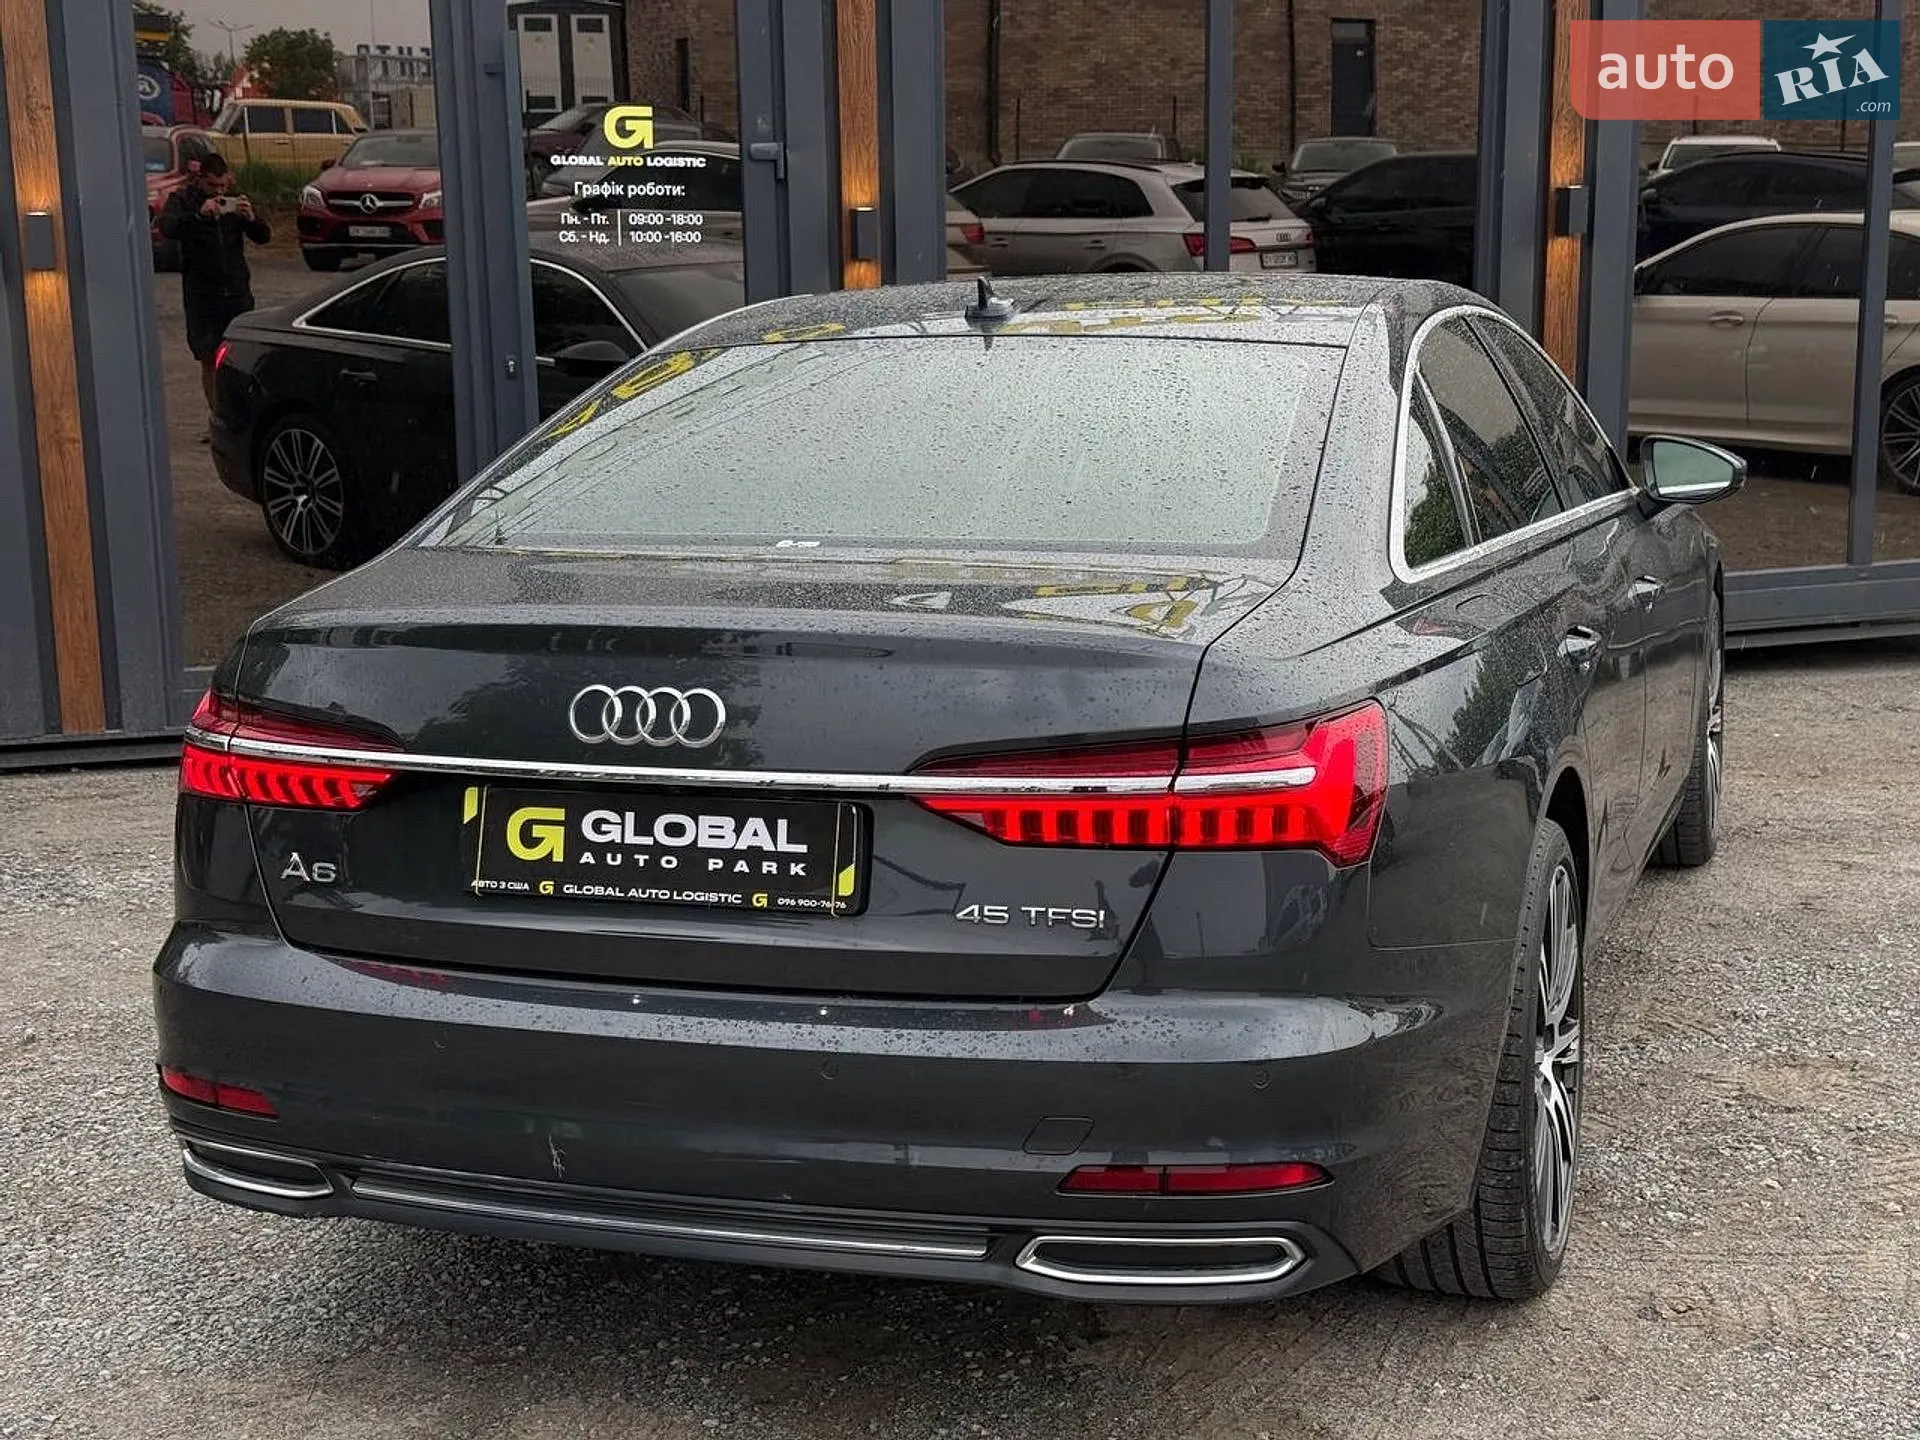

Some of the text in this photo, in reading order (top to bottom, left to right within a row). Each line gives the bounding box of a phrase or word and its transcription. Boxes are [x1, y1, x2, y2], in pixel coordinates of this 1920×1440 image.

[550, 154, 707, 168] GLOBAL AUTO LOGISTIC
[574, 181, 686, 198] Графік роботи:
[561, 213, 581, 225] Пн.
[591, 213, 610, 225] Пт.
[559, 230, 580, 243] Сб.
[581, 809, 808, 853] GLOBAL
[280, 851, 337, 883] A6
[580, 851, 807, 876] AUTO PARK
[471, 880, 498, 889] АВТО
[507, 882, 530, 890] США
[563, 884, 625, 897] GLOBAL
[627, 887, 670, 900] AUTO
[673, 890, 742, 903] LOGISTIC
[777, 897, 796, 906] 096
[956, 904, 1105, 929] 45 TFSI
